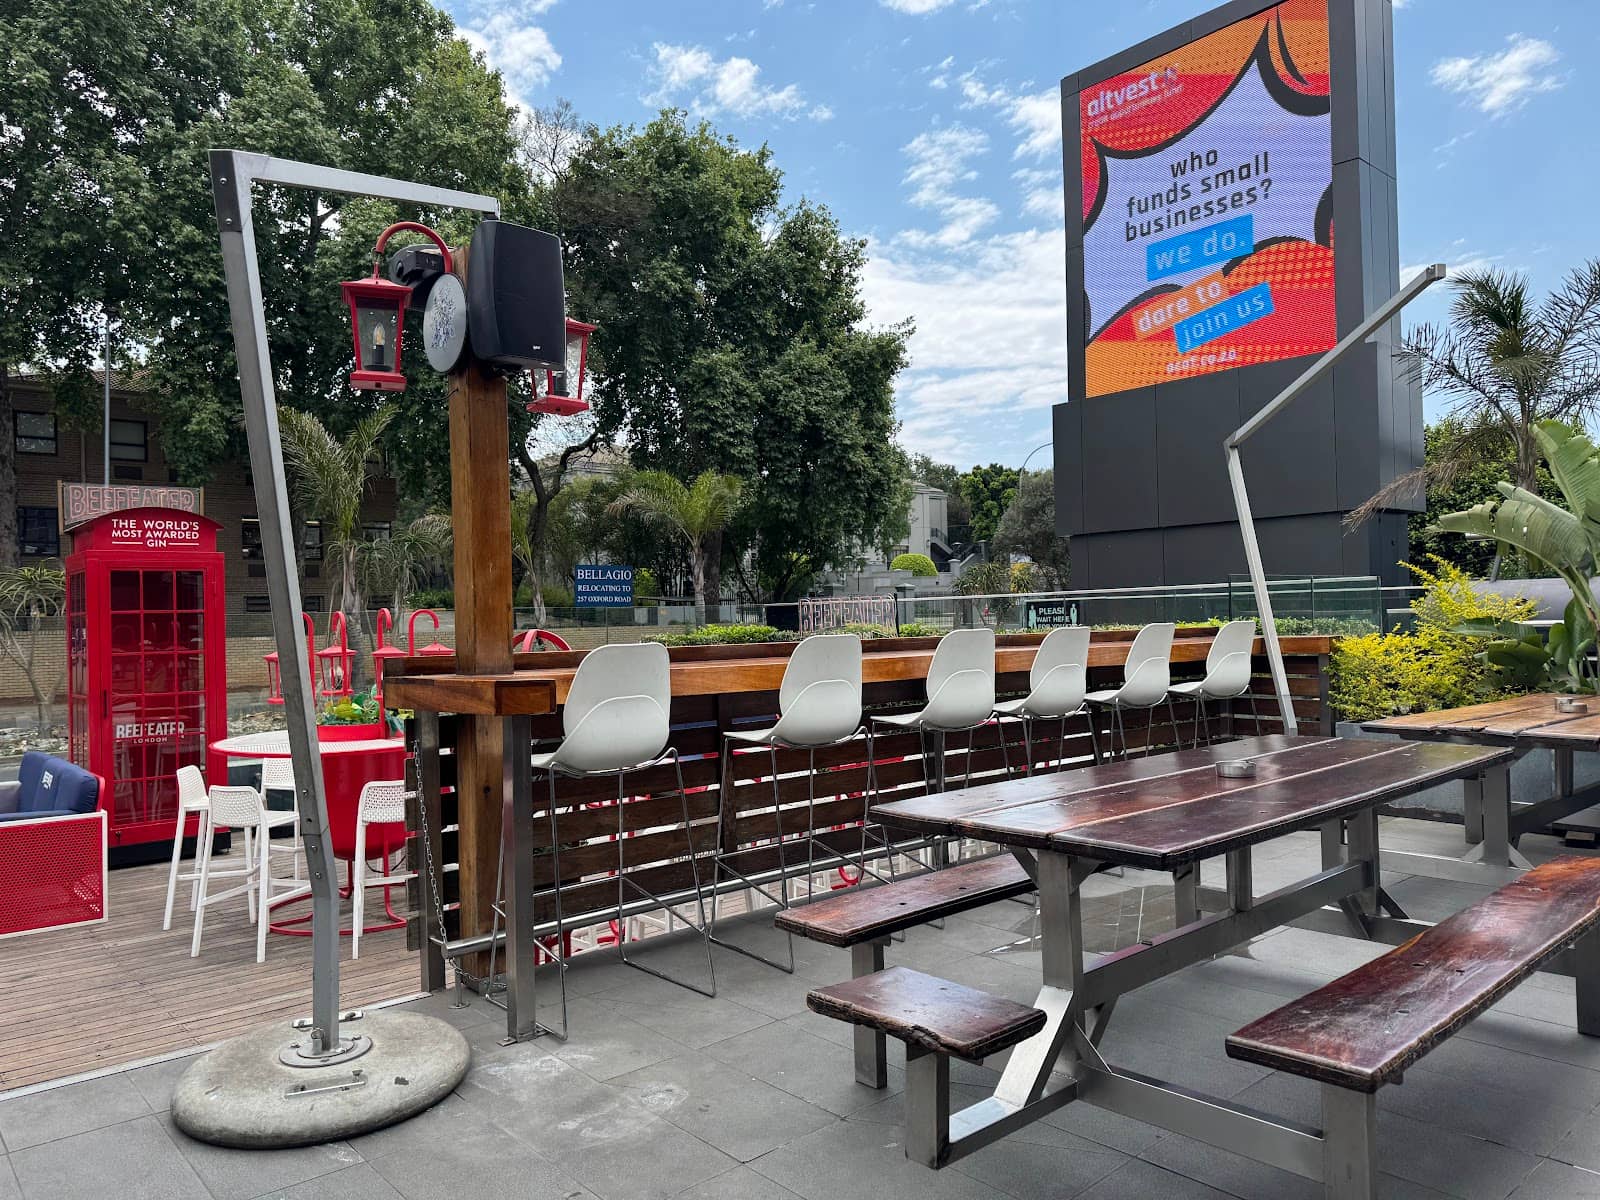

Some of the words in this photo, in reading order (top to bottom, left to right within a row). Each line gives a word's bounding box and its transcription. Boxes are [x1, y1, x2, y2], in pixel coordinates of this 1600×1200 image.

[1087, 71, 1159, 117] altvest
[1170, 148, 1218, 179] who
[1126, 181, 1191, 218] funds
[1201, 151, 1269, 194] small
[1125, 178, 1273, 242] businesses?
[1155, 244, 1191, 271] we
[1203, 230, 1246, 256] do.
[1137, 296, 1190, 333] dare
[1196, 280, 1222, 305] to
[1182, 309, 1229, 347] join
[1236, 293, 1265, 319] us
[69, 485, 195, 519] BEEFEATER
[111, 529, 143, 538] MOST
[145, 529, 200, 540] AWARDED
[112, 518, 137, 529] THE
[143, 519, 200, 531] WORLD'S
[146, 538, 167, 548] GIN
[577, 569, 632, 580] BELLAGIO
[577, 584, 621, 592] RELOCATING
[588, 595, 614, 603] OXFORD
[614, 595, 632, 603] ROAD
[133, 736, 168, 745] LONDON
